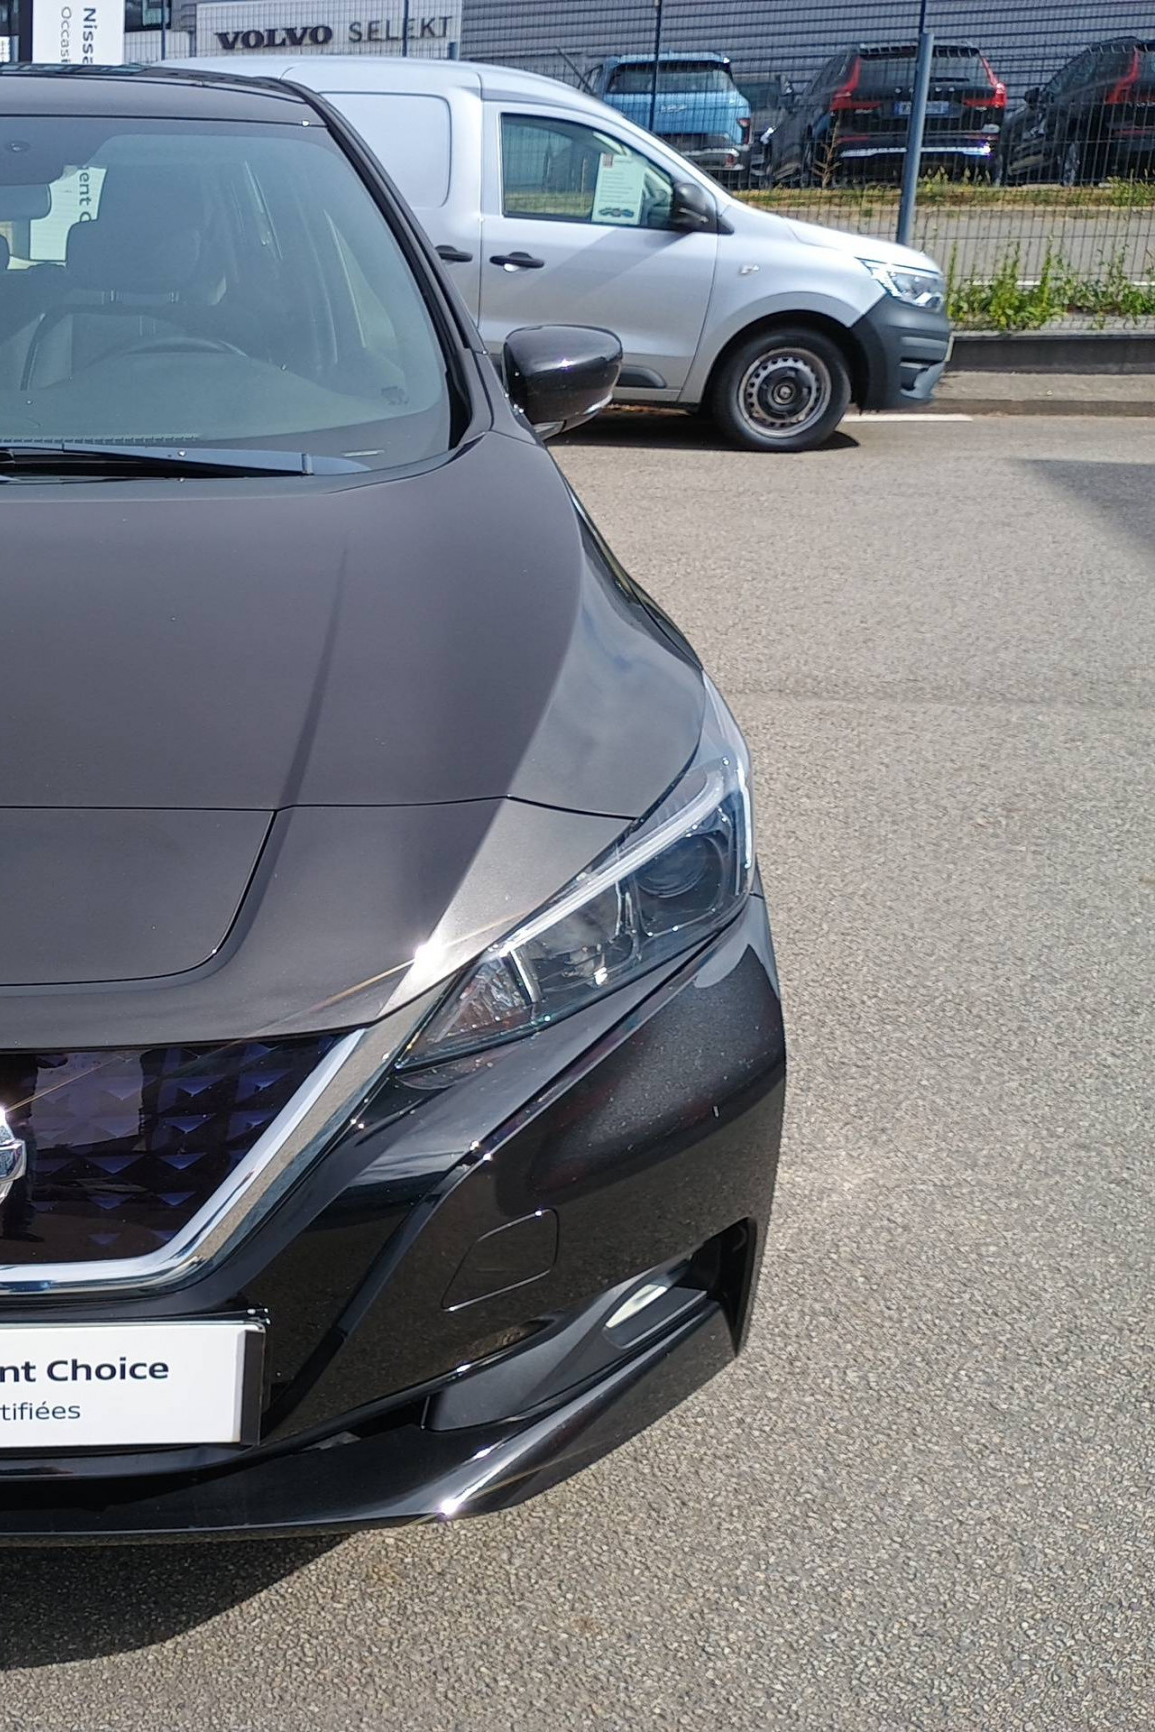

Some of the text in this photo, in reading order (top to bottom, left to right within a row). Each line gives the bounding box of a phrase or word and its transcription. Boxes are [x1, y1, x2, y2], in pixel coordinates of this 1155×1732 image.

[214, 15, 453, 50] VOLVO SELEKT
[78, 166, 92, 206] ent
[46, 1356, 170, 1382] Choice
